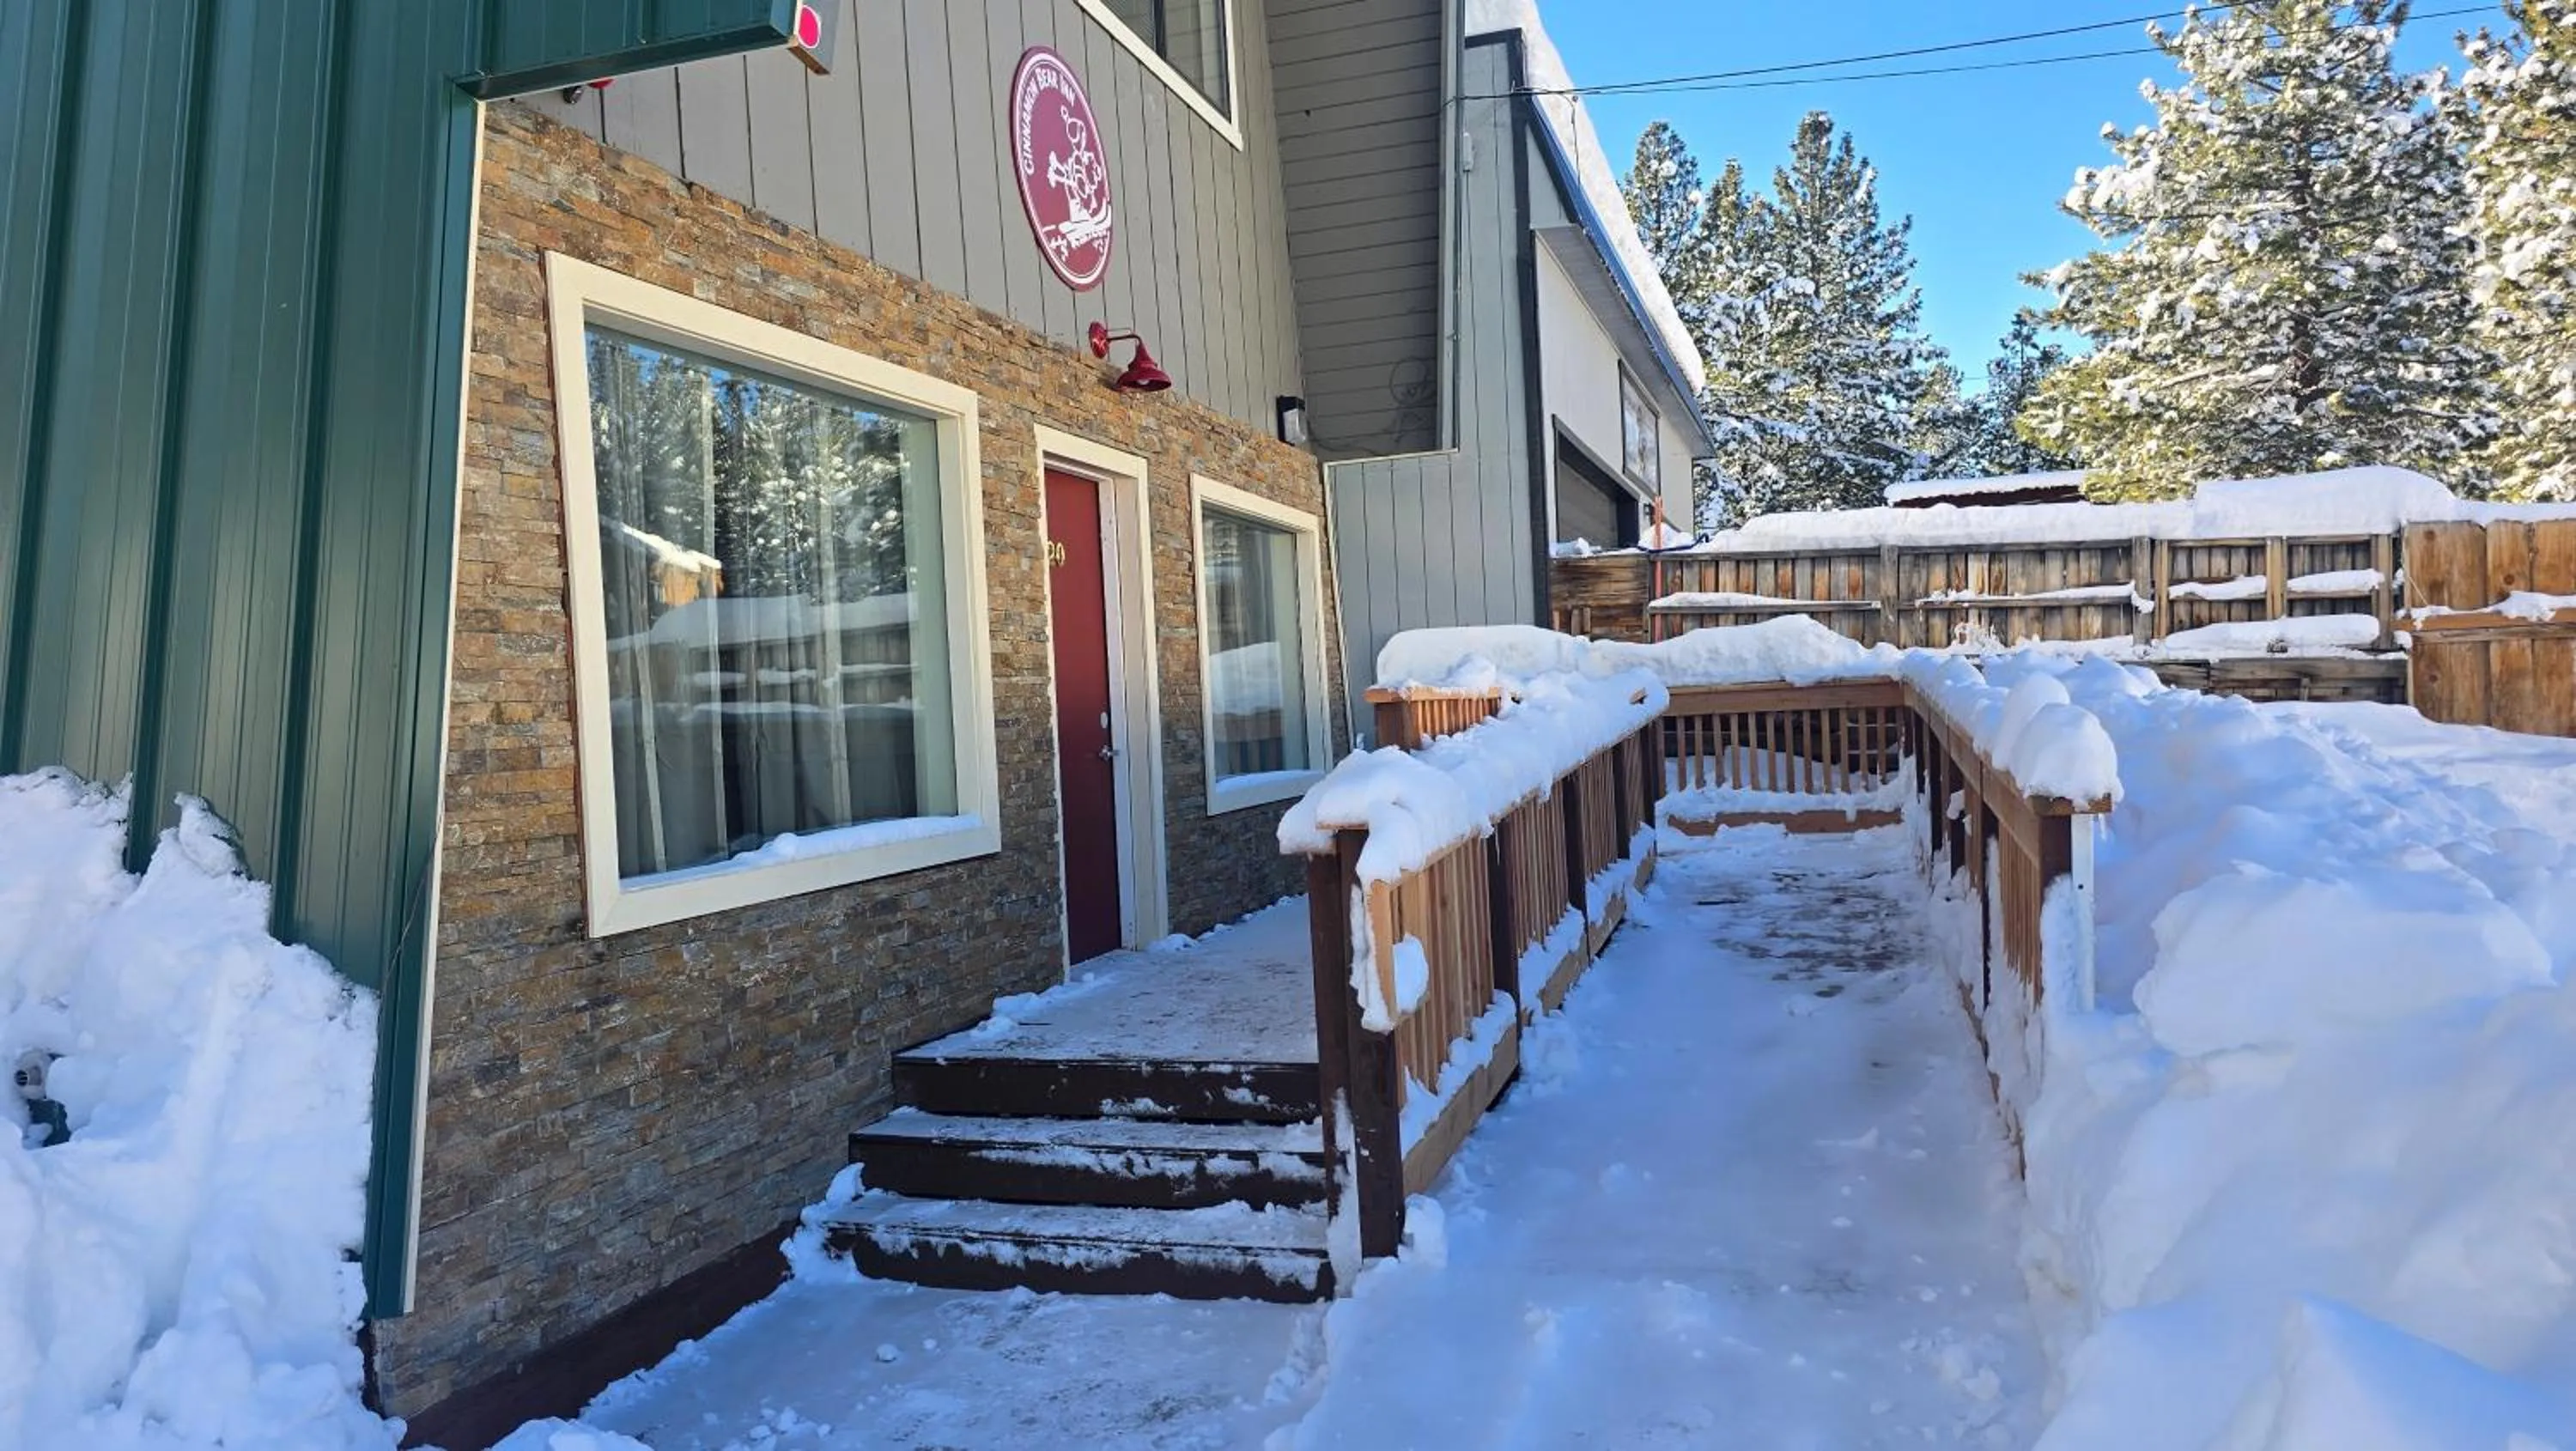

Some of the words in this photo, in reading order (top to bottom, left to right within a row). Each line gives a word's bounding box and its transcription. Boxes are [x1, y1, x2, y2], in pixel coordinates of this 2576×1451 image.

[1022, 76, 1040, 175] CINNAMON
[1035, 67, 1059, 91] BEAR
[1059, 73, 1075, 107] INN
